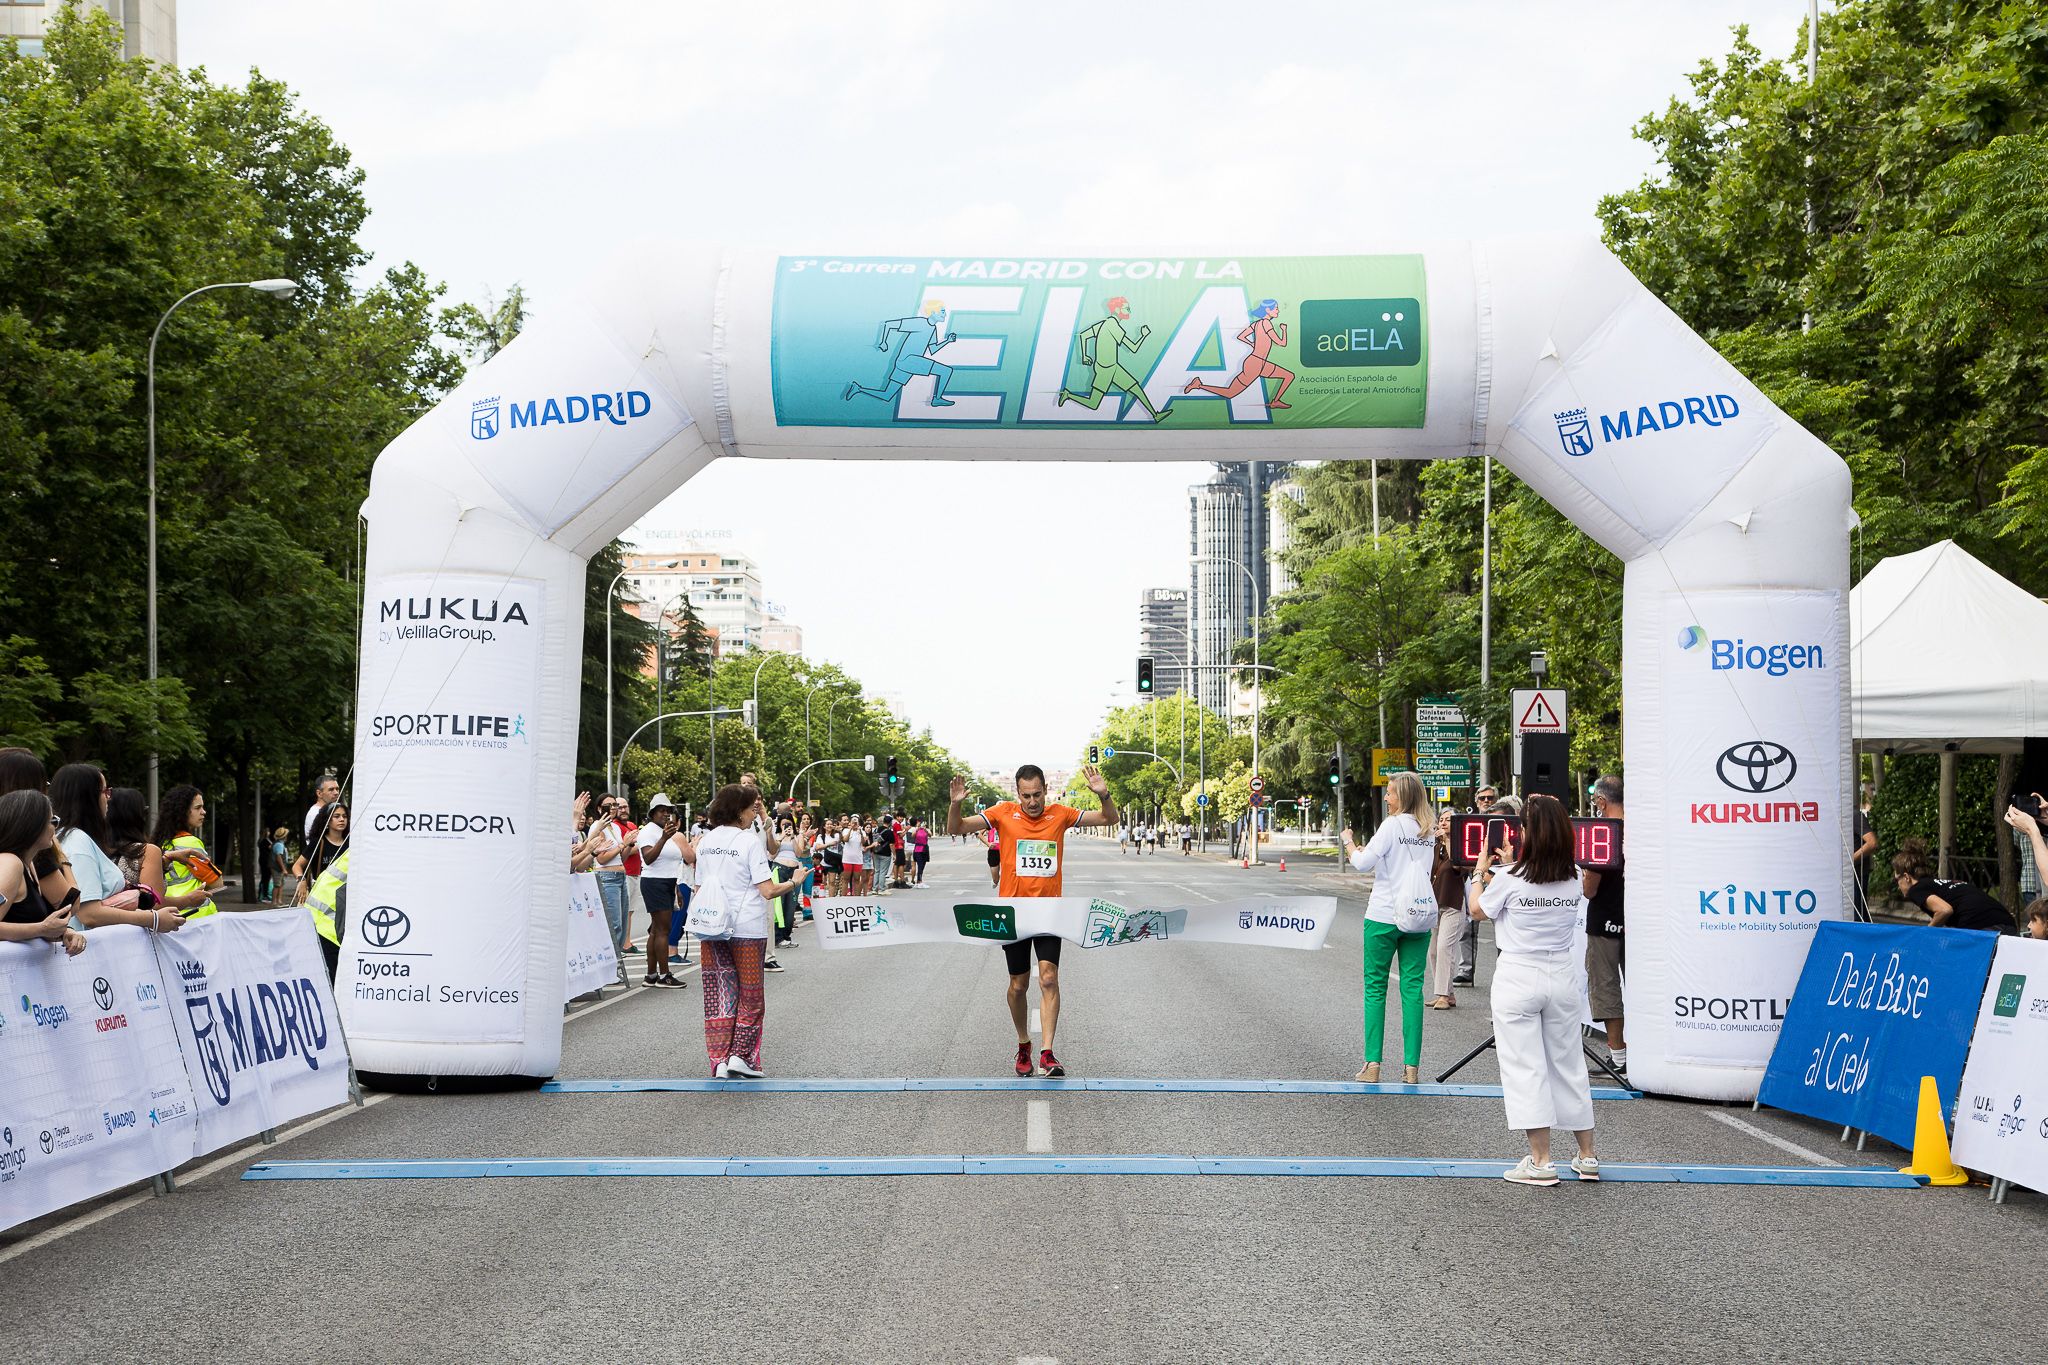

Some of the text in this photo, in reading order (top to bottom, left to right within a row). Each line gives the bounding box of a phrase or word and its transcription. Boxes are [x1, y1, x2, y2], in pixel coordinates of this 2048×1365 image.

[823, 260, 917, 274] Carrera
[926, 260, 1087, 279] MADRID
[1099, 260, 1185, 280] CON
[1193, 260, 1242, 279] LA
[1317, 327, 1404, 352] adELA
[893, 282, 1273, 425] ELA
[1299, 374, 1398, 384] Asociación Española de
[1299, 386, 1421, 395] Esclerosis Lateral Amiotrófica
[510, 390, 651, 429] MADRID
[1600, 394, 1740, 443] MADRID
[1154, 589, 1186, 601] BBVA
[380, 597, 529, 626] MUKUA
[379, 625, 496, 644] by VelillaGroup.
[1433, 730, 1462, 738] Germán
[405, 738, 464, 747] COMUNICACIÓN
[472, 739, 508, 749] EVENTOS
[1021, 857, 1052, 869] 1319
[826, 905, 874, 920] SPORT
[1090, 904, 1127, 919] MADRID
[1128, 910, 1148, 919] CON
[1100, 900, 1126, 912] Carrera
[834, 918, 871, 934] LIFE
[965, 918, 1008, 934] adELA
[1256, 915, 1316, 933] MADRID
[1700, 920, 1818, 933] Flexible Mobility Solutions
[357, 958, 411, 980] Toyota
[355, 982, 519, 1004] Financial Services
[1826, 951, 1929, 1020] De la Base
[32, 1003, 69, 1030] Biogen
[216, 978, 327, 1073] MADRID
[1675, 1020, 1719, 1031] MOVILIDAD,
[1804, 1031, 1870, 1095] al Cielo
[110, 1110, 136, 1129] MADRID
[54, 1125, 70, 1138] Toyota
[57, 1131, 95, 1151] Financial Services
